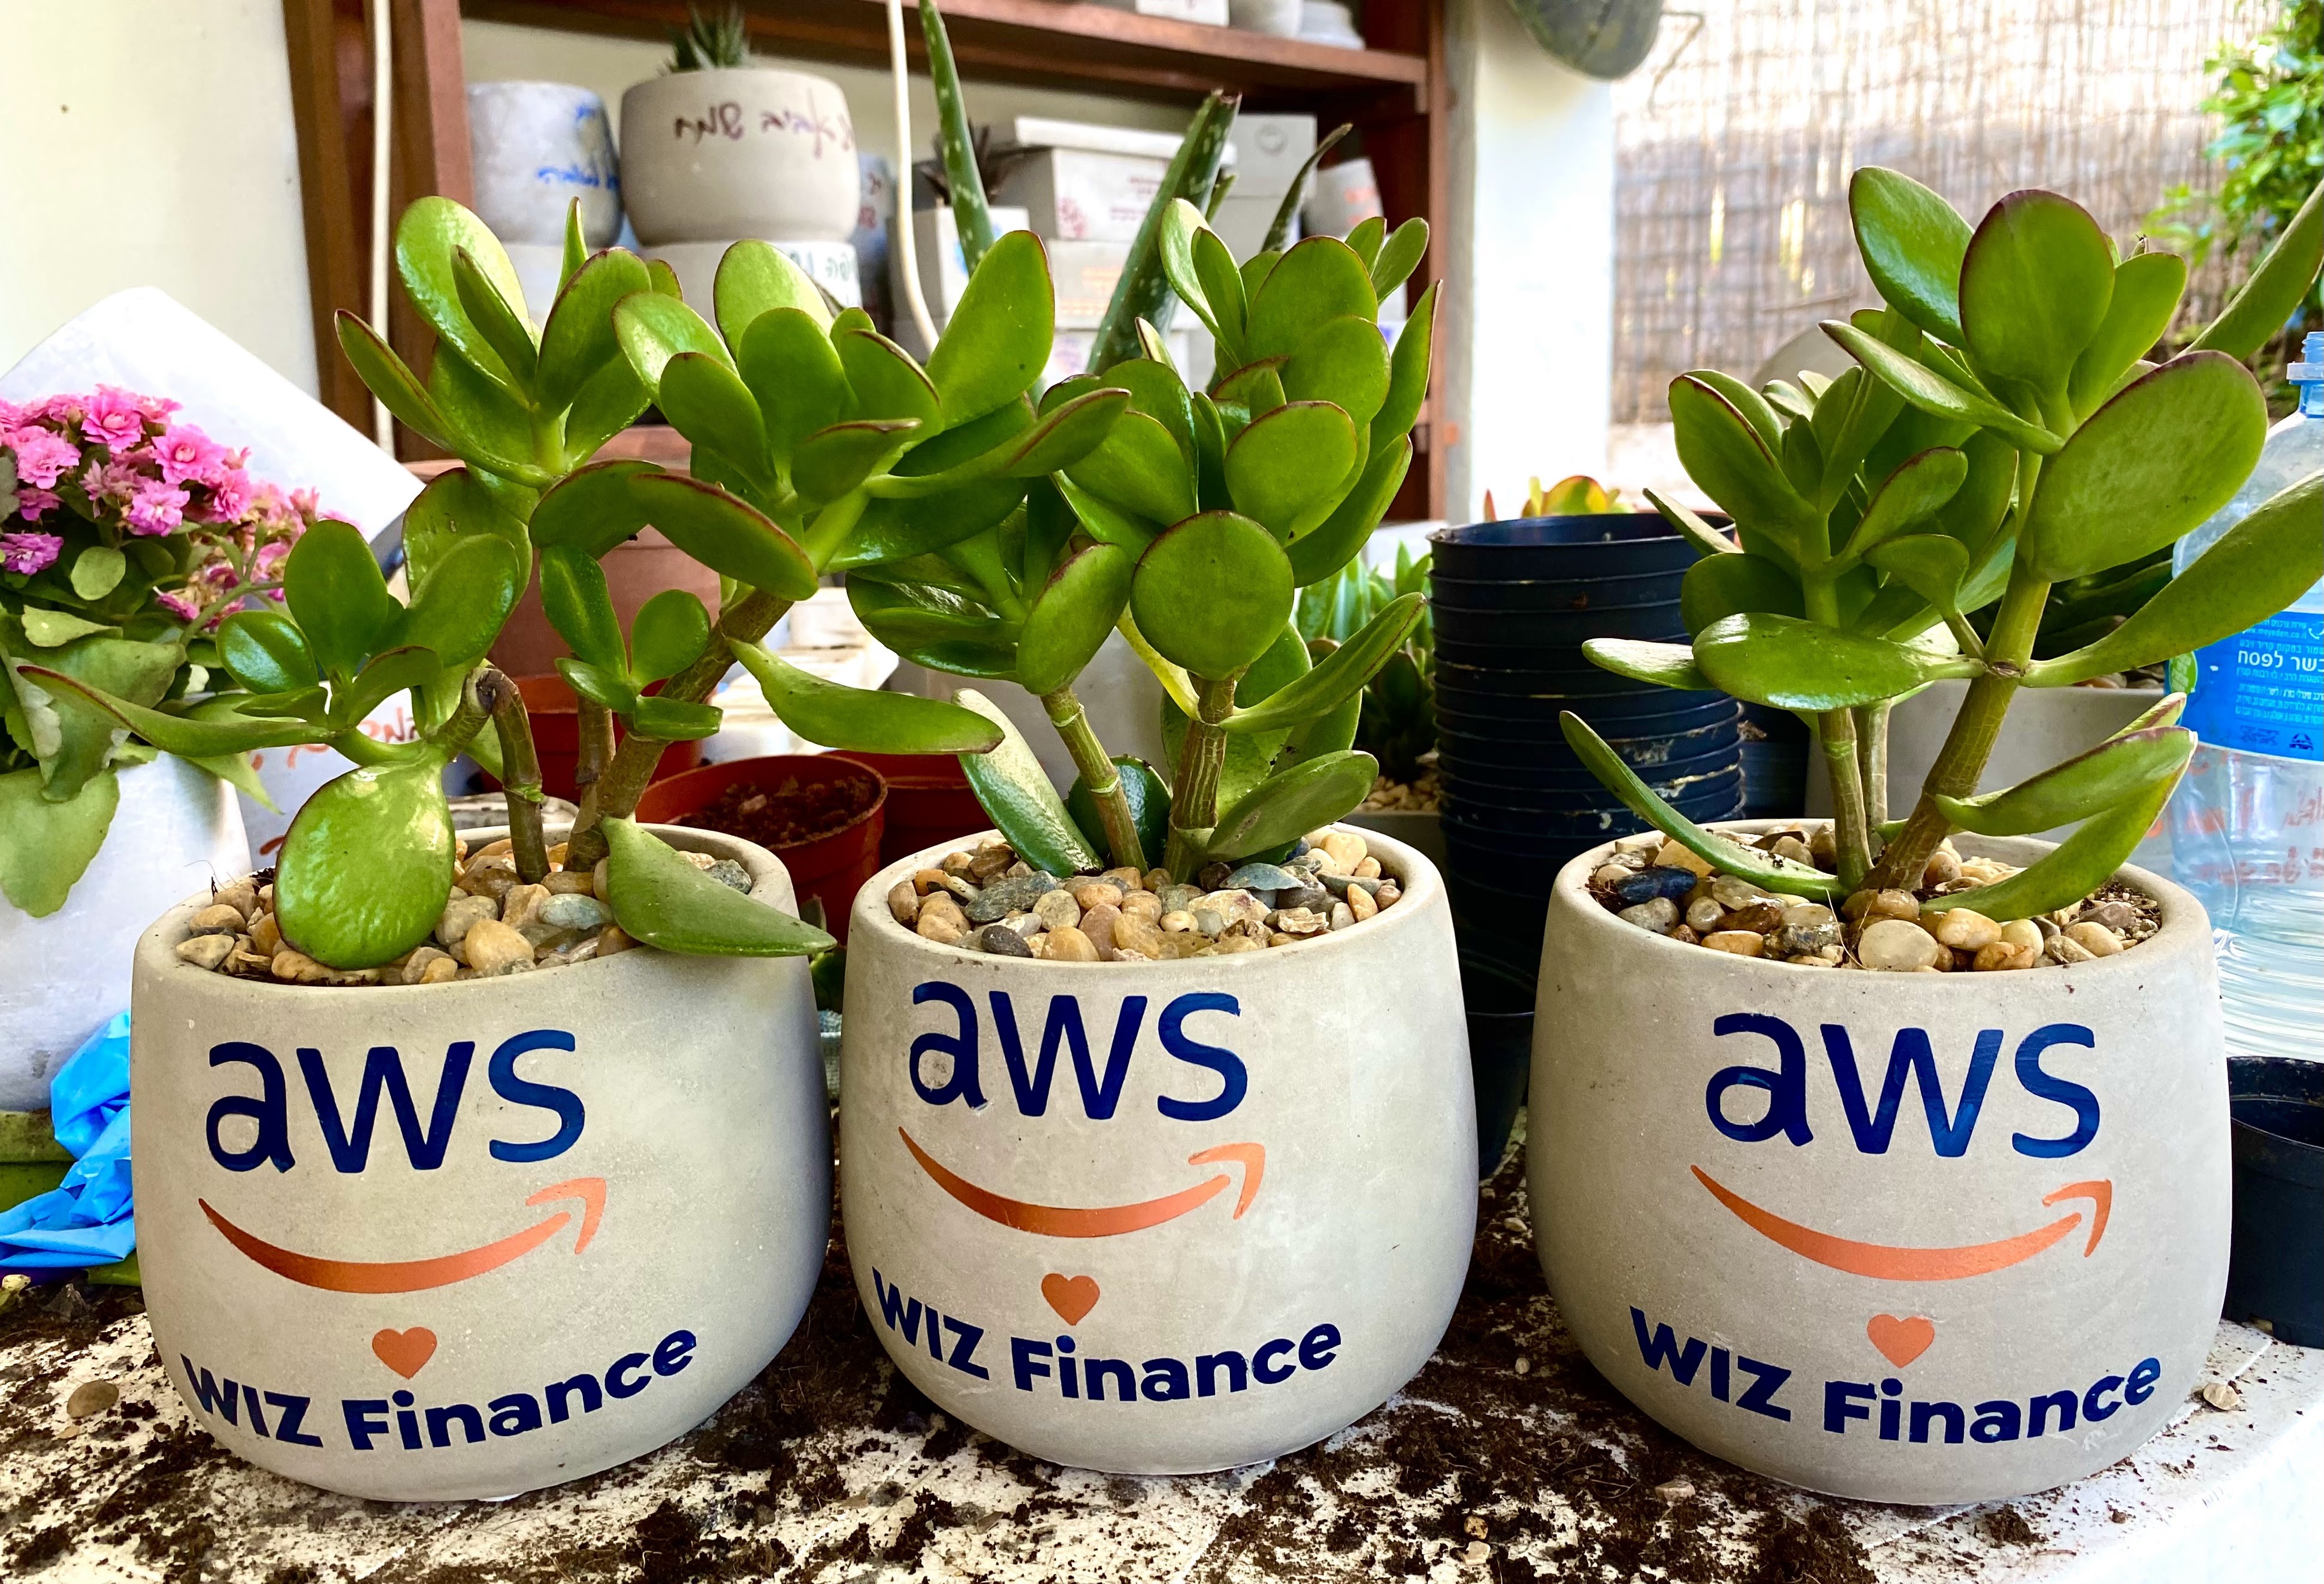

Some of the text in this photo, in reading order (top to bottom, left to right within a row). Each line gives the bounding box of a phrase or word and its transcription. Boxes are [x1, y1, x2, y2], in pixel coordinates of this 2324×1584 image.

[2238, 650, 2283, 668] לפסח
[205, 1029, 586, 1174] aws
[909, 981, 1249, 1122] aws
[1705, 1012, 2101, 1159] aws
[180, 1329, 697, 1451] WIZ Finance
[872, 1266, 1342, 1402] WIZ Finance
[1629, 1305, 2162, 1444] WIZ Finance
